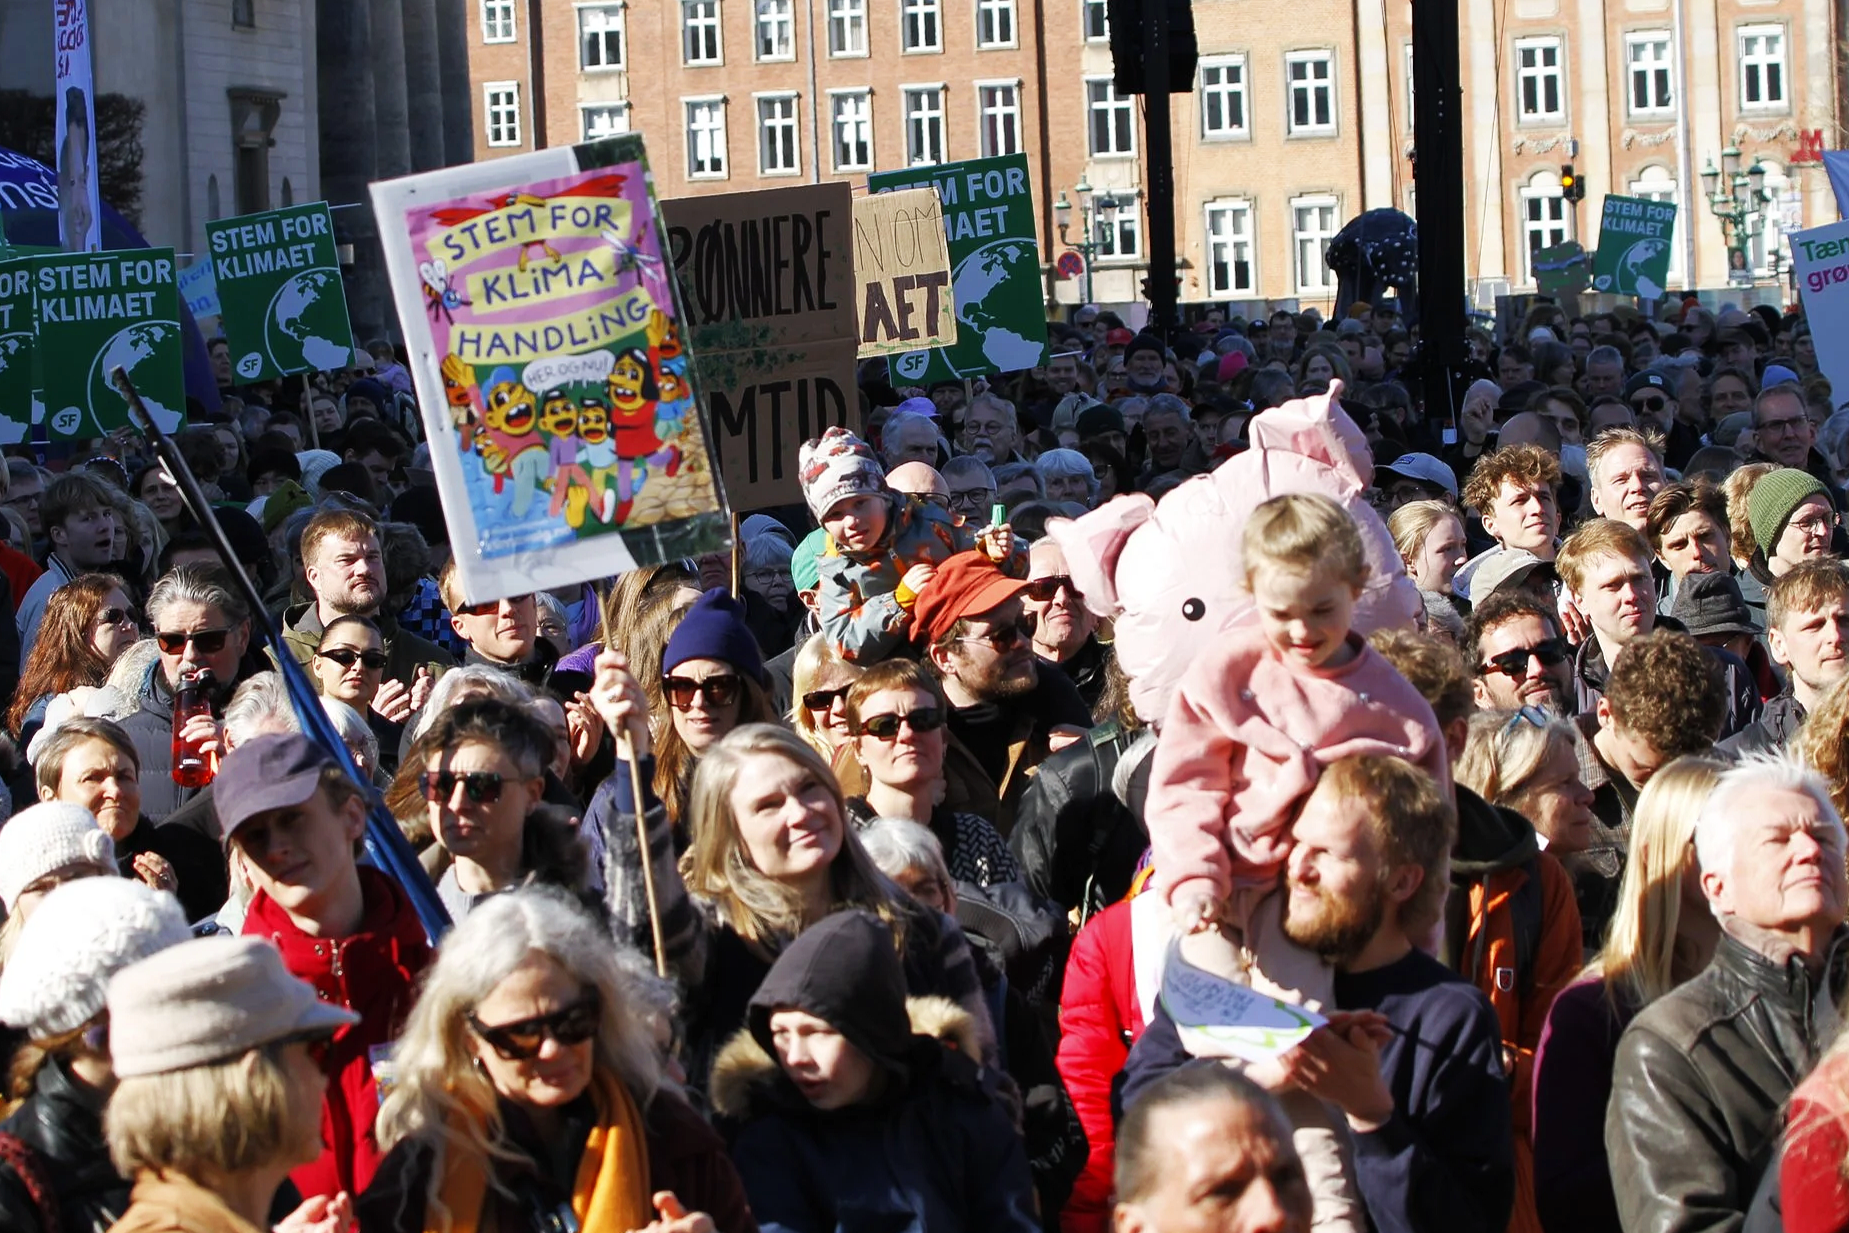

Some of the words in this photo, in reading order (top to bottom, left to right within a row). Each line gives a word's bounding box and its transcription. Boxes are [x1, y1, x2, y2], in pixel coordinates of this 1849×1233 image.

[966, 167, 1026, 201] FOR
[1602, 216, 1664, 237] KLIMAET
[1604, 200, 1643, 217] STEM
[1646, 205, 1675, 221] FOR
[212, 222, 276, 253] STEM
[281, 213, 327, 241] FOR
[444, 208, 536, 261] STEM
[551, 204, 618, 231] FOR
[39, 263, 111, 291] STEM
[120, 259, 172, 286] FOR
[217, 243, 315, 280] KLIMAET
[667, 210, 837, 326] RØNNERE
[1807, 264, 1849, 293] grø
[42, 291, 156, 323] KLIMAET
[857, 270, 949, 344] AET
[243, 358, 259, 373] SF
[525, 365, 555, 387] HER
[904, 355, 924, 372] SF
[59, 414, 77, 428] SF
